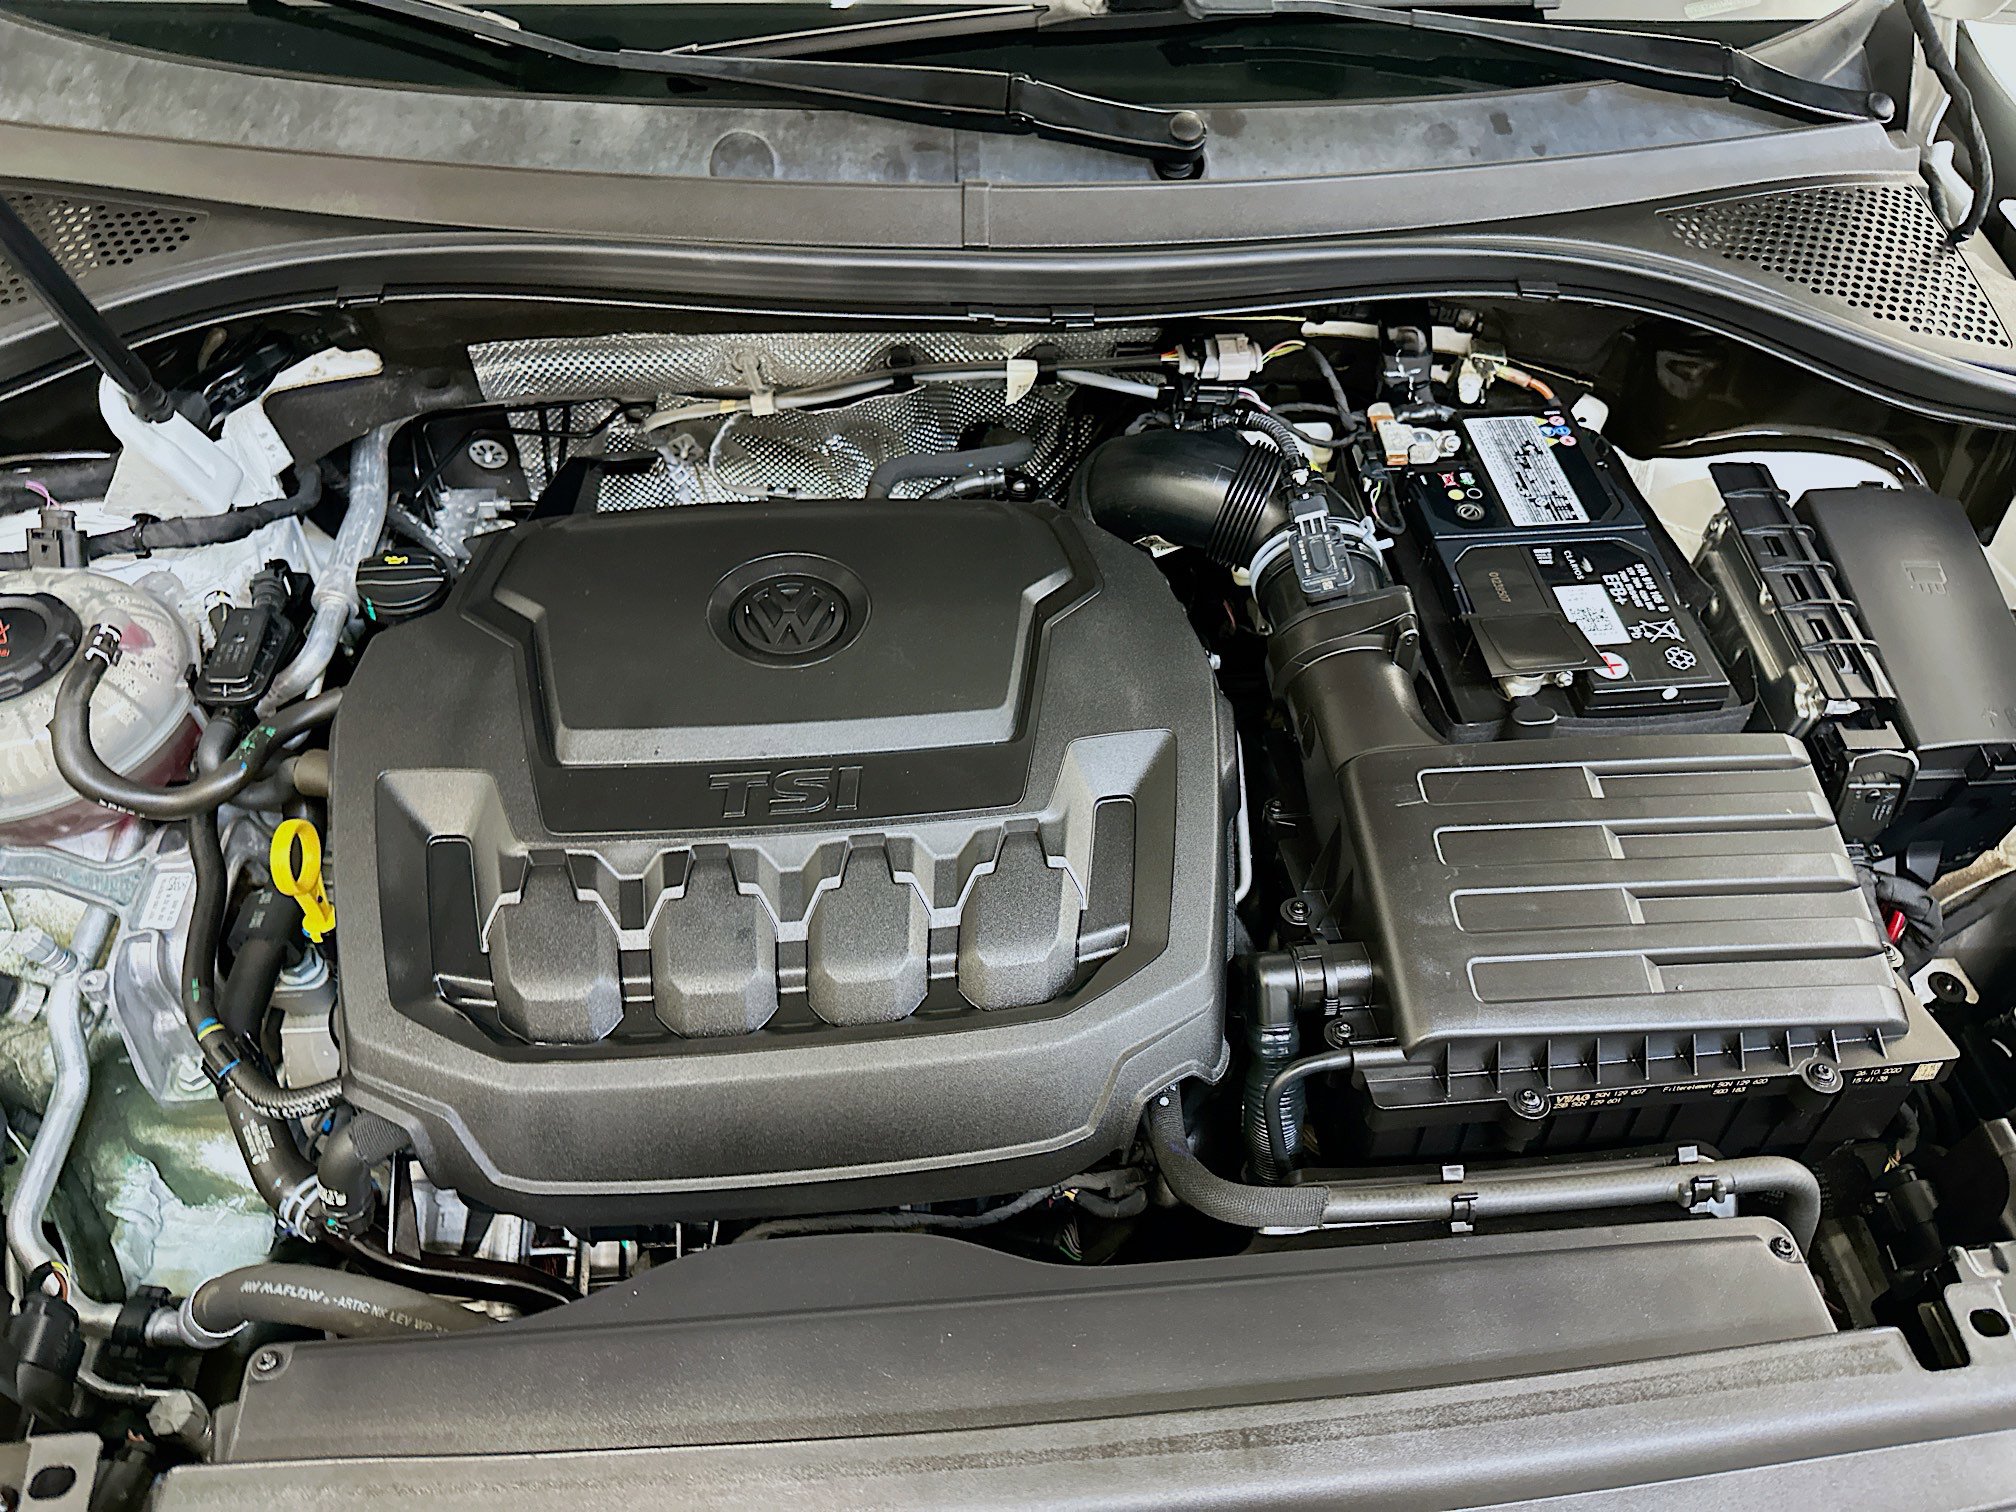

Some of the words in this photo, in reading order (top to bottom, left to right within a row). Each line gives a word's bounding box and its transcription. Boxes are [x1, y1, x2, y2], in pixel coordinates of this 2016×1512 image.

[1563, 550, 1585, 580] CLARIOS
[1602, 574, 1628, 605] EFB+
[1628, 626, 1643, 639] Pb
[709, 766, 863, 818] TSI
